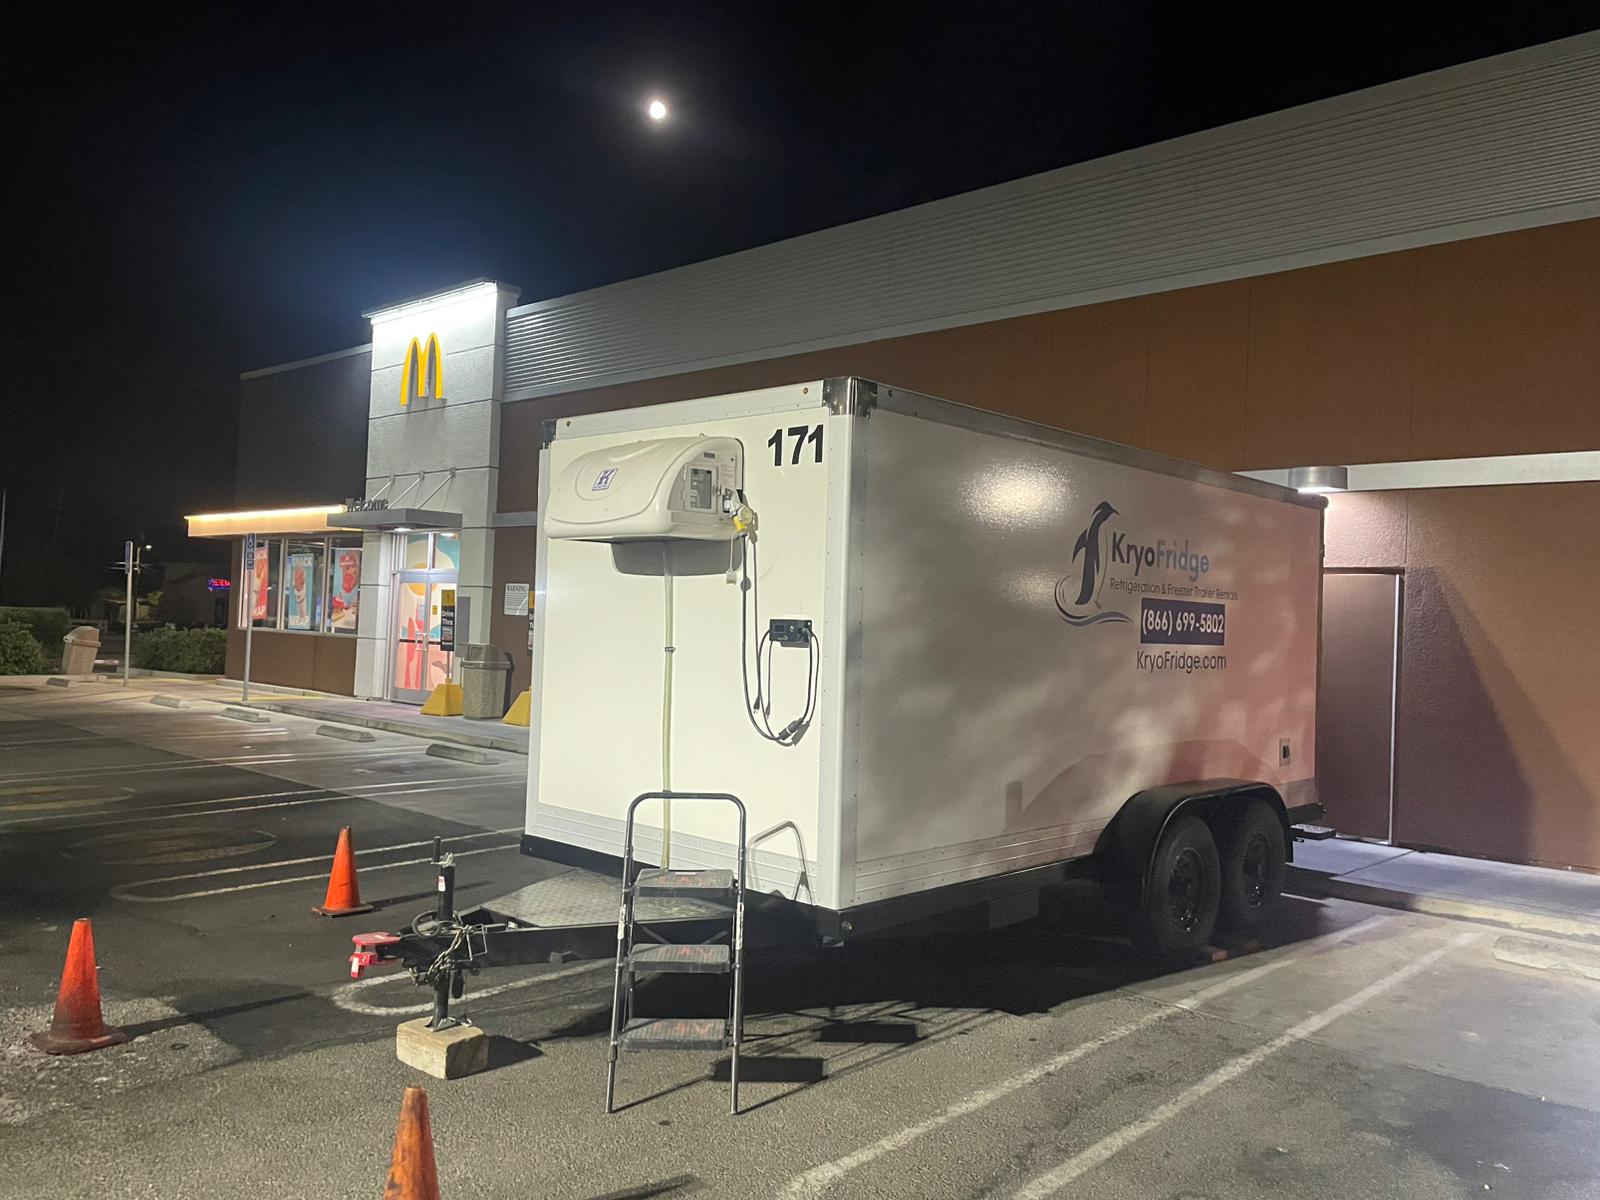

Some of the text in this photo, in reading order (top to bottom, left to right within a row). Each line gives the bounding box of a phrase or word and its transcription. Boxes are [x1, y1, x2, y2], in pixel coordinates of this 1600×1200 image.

[768, 424, 823, 466] 171
[1111, 532, 1210, 582] KryoFridge
[1110, 577, 1160, 594] Refrigeration
[1161, 583, 1166, 595] &
[1167, 583, 1194, 597] Freezer
[1195, 586, 1216, 599] Trailer
[1143, 609, 1224, 636] (866) 699-5802
[1137, 651, 1227, 673] KryoFridge.com
